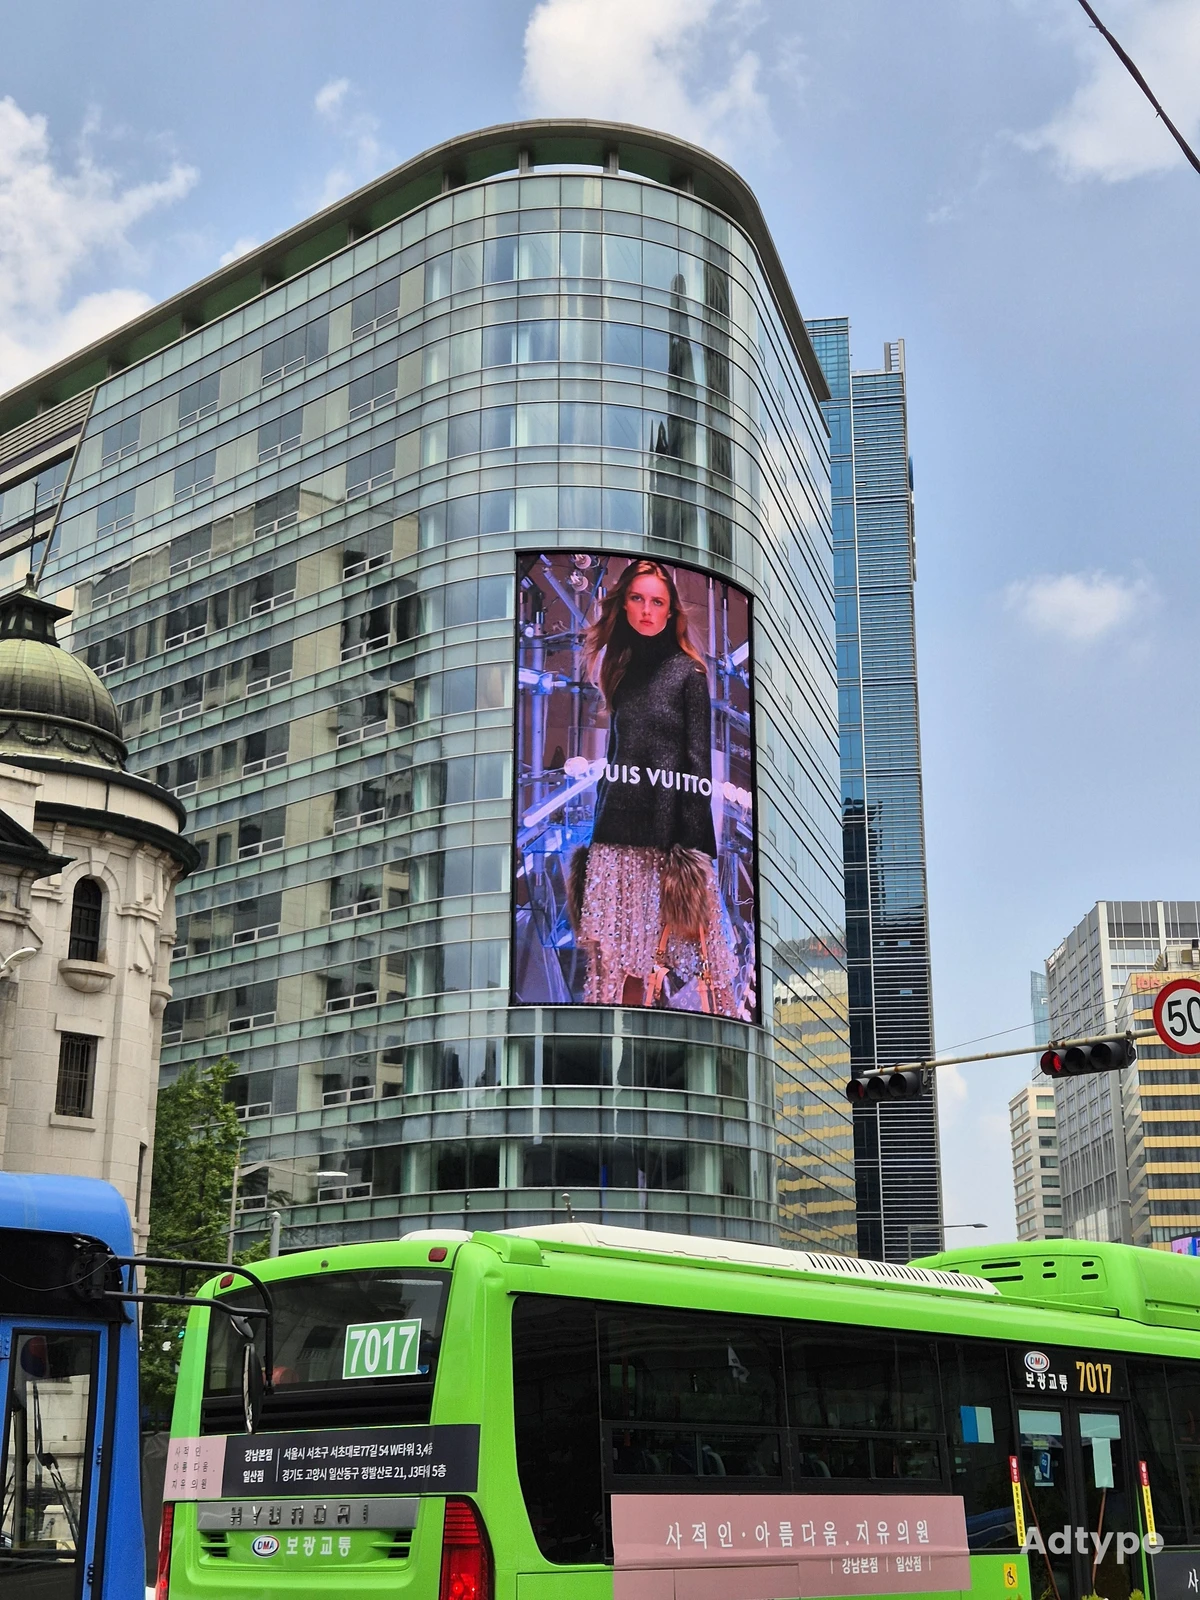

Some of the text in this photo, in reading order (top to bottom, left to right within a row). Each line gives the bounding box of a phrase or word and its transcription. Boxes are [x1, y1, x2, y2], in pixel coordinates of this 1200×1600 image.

[646, 767, 716, 797] VUITTO
[1167, 996, 1200, 1037] 50
[350, 1326, 416, 1374] 7017
[1030, 1357, 1045, 1366] DMA
[1025, 1371, 1068, 1392] 보광교통
[1075, 1361, 1112, 1394] 7017
[244, 1448, 273, 1463] 강남본점
[283, 1447, 306, 1461] 서울시
[306, 1446, 329, 1459] 서초구
[330, 1444, 378, 1459] 서초대로77길
[378, 1445, 389, 1456] 54
[390, 1442, 415, 1457] W타워
[243, 1469, 265, 1484] 일산점
[282, 1463, 447, 1482] 경기도 고양시 일산동구 정발산로 21, J3타워 5층
[230, 1502, 369, 1526] HYUNDAI
[257, 1540, 275, 1550] DMA
[286, 1536, 352, 1557] 보광교통
[841, 1554, 922, 1575] 강남본점 일산점
